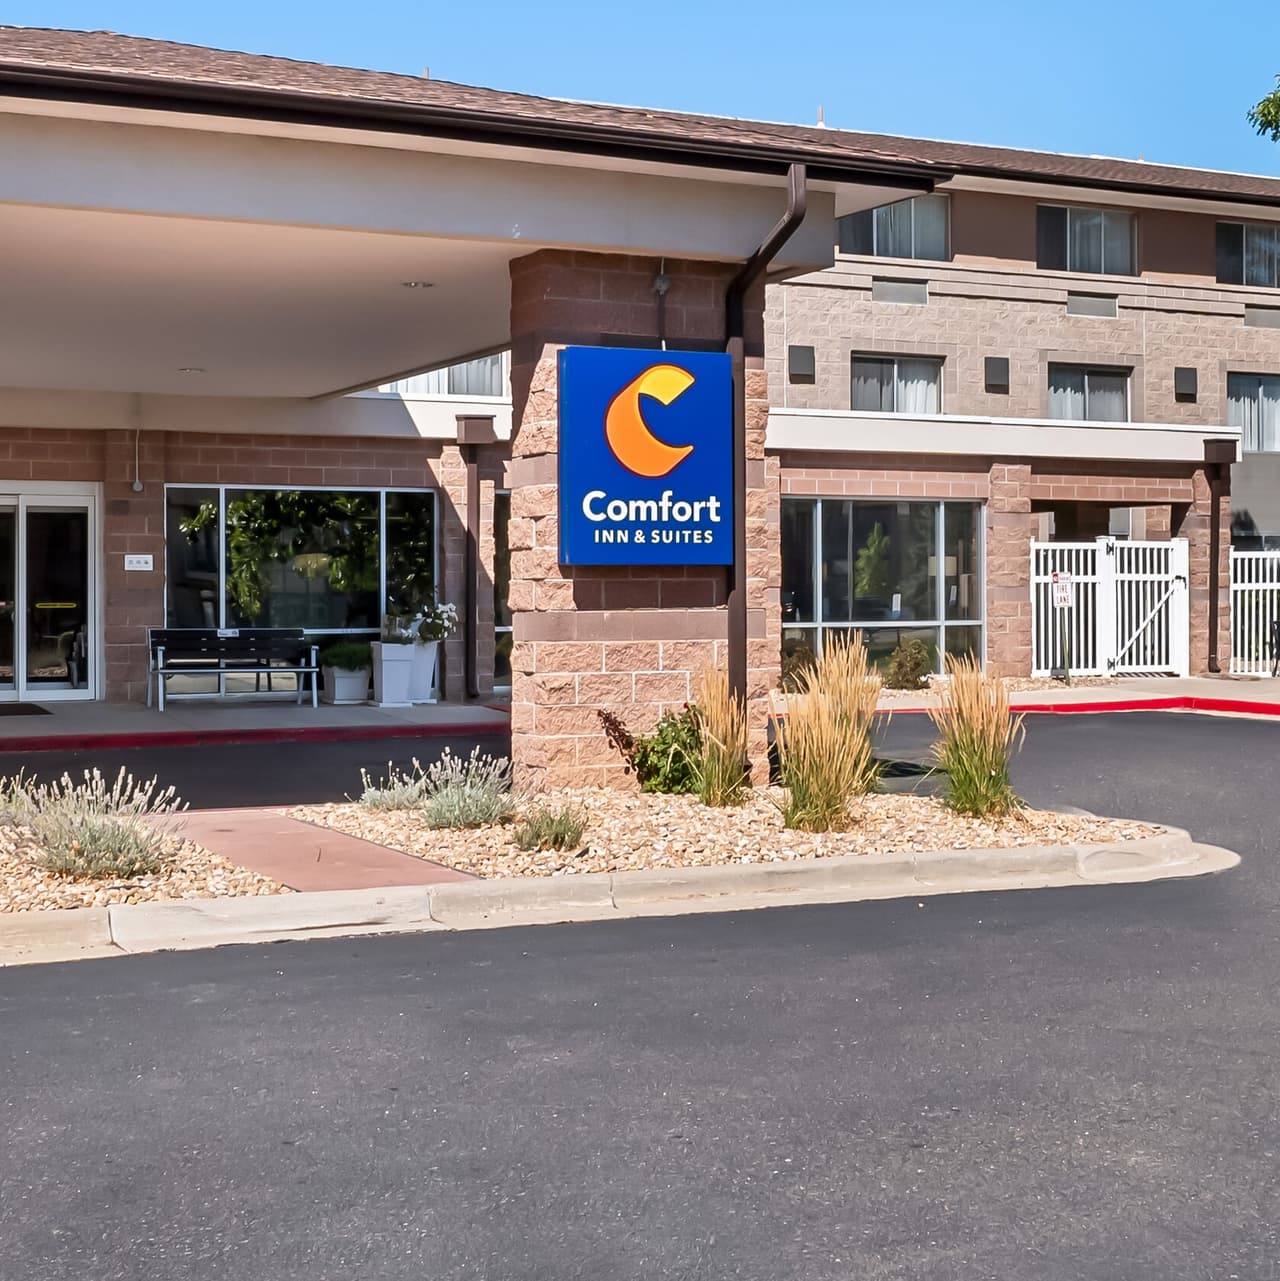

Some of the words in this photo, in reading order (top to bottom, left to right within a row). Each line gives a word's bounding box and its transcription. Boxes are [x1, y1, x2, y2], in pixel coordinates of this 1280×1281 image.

[582, 489, 721, 522] Comfort
[594, 529, 629, 544] INN
[633, 529, 646, 544] &
[651, 529, 713, 544] SUITES
